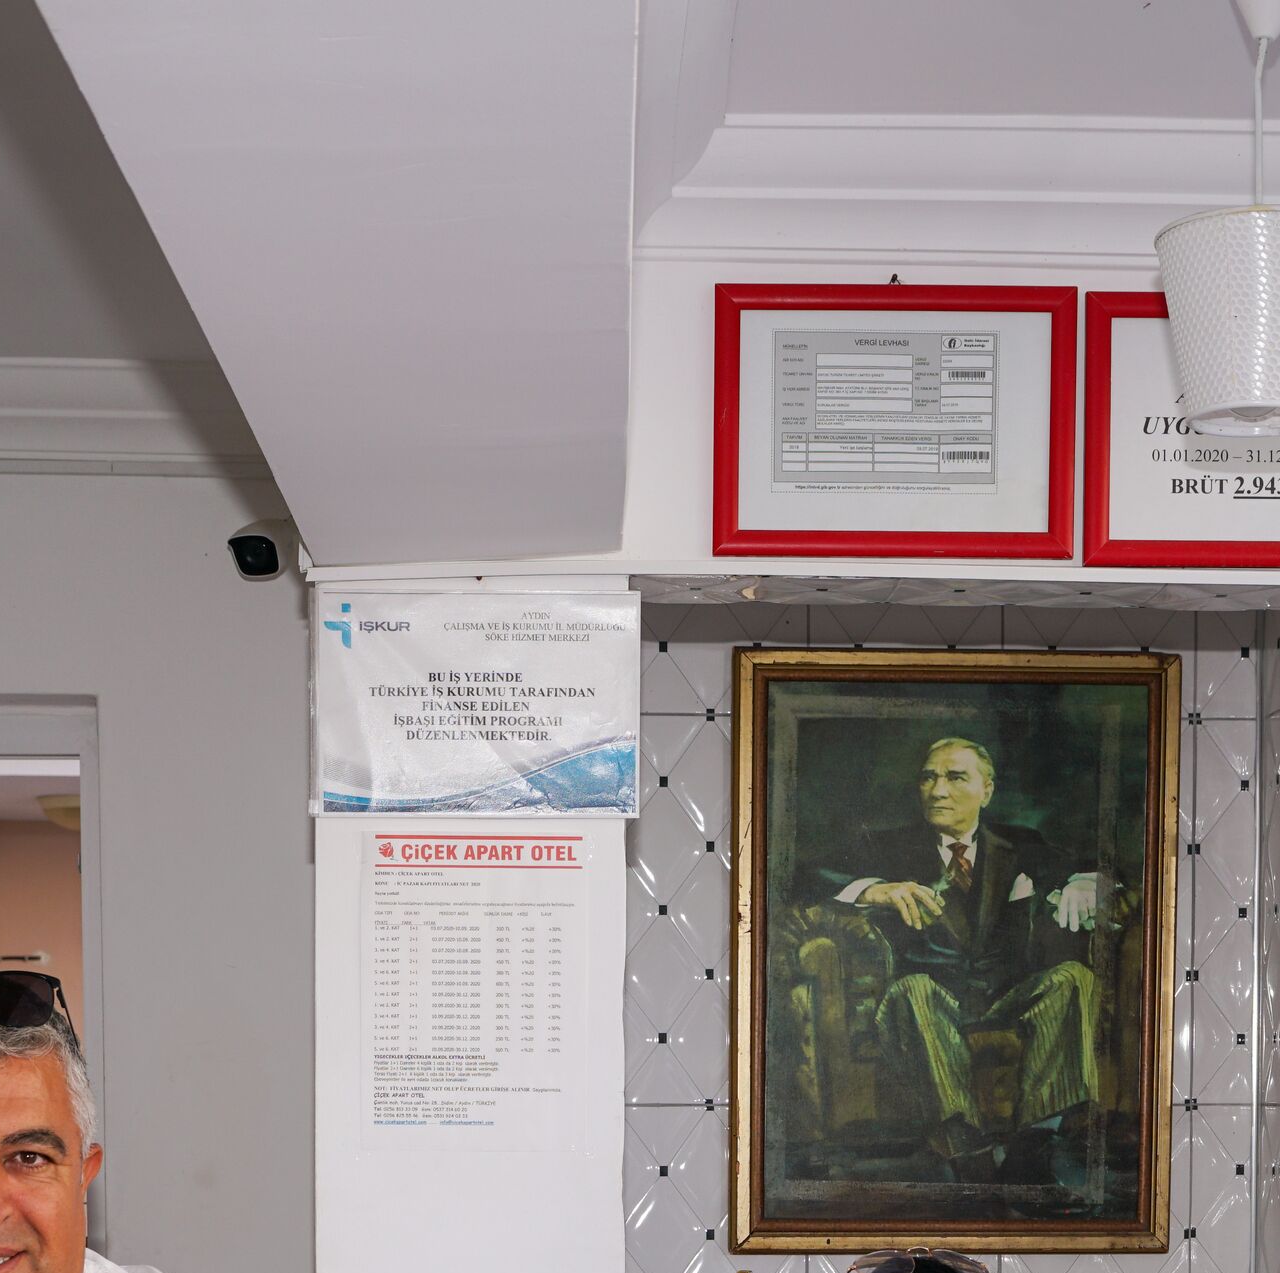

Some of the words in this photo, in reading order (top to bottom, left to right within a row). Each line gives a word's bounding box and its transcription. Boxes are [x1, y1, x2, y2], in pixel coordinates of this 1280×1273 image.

[854, 338, 878, 347] VERGİ
[878, 339, 910, 347] LEVHASI
[1151, 448, 1229, 463] 01.01.2020
[1171, 474, 1229, 495] BRÜT
[521, 612, 551, 620] AYDIN
[443, 622, 486, 633] ÇALIŞMA
[488, 623, 500, 631] VE
[502, 621, 511, 633] İŞ
[512, 622, 554, 631] KURUMU
[555, 621, 565, 631] İL
[484, 632, 509, 642] SÖKE
[548, 632, 590, 642] MERKEZİ
[428, 672, 446, 683] BU
[449, 670, 461, 685] İŞ
[464, 670, 523, 683] YERİNDE
[368, 684, 429, 697] TÜRKİYE
[431, 684, 444, 699] İŞ
[446, 686, 506, 697] KURUMU
[508, 686, 596, 698] TARAFINDAN
[422, 699, 478, 712] FİNANSE
[481, 699, 530, 712] EDİLEN
[393, 713, 435, 729] İŞBAŞI
[438, 713, 486, 727] EĞİTİM
[490, 716, 563, 727] PROGRAMI
[406, 728, 552, 742] DÜZENLENMEKTEDİR.
[463, 844, 525, 861] APART
[530, 845, 578, 862] OTEL
